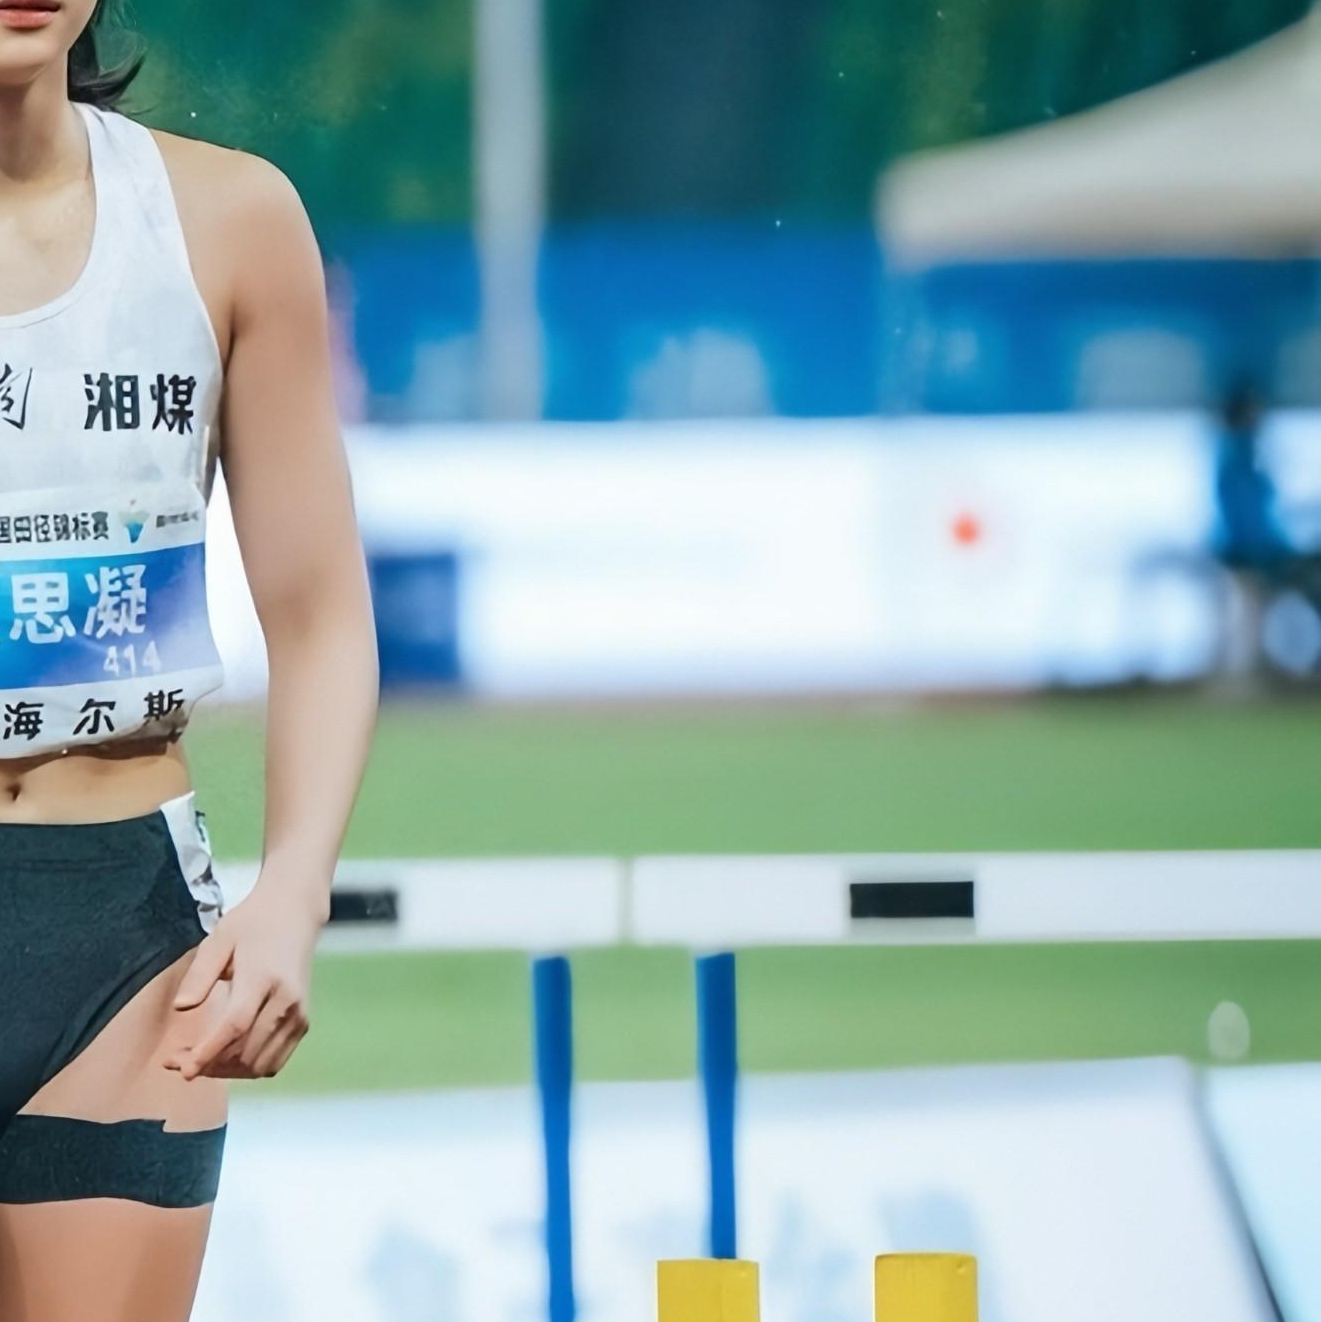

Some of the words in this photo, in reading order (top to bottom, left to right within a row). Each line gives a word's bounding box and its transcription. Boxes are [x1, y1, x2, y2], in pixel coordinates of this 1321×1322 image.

[83, 372, 198, 436] 湘煤
[2, 688, 185, 741] 海尔斯
